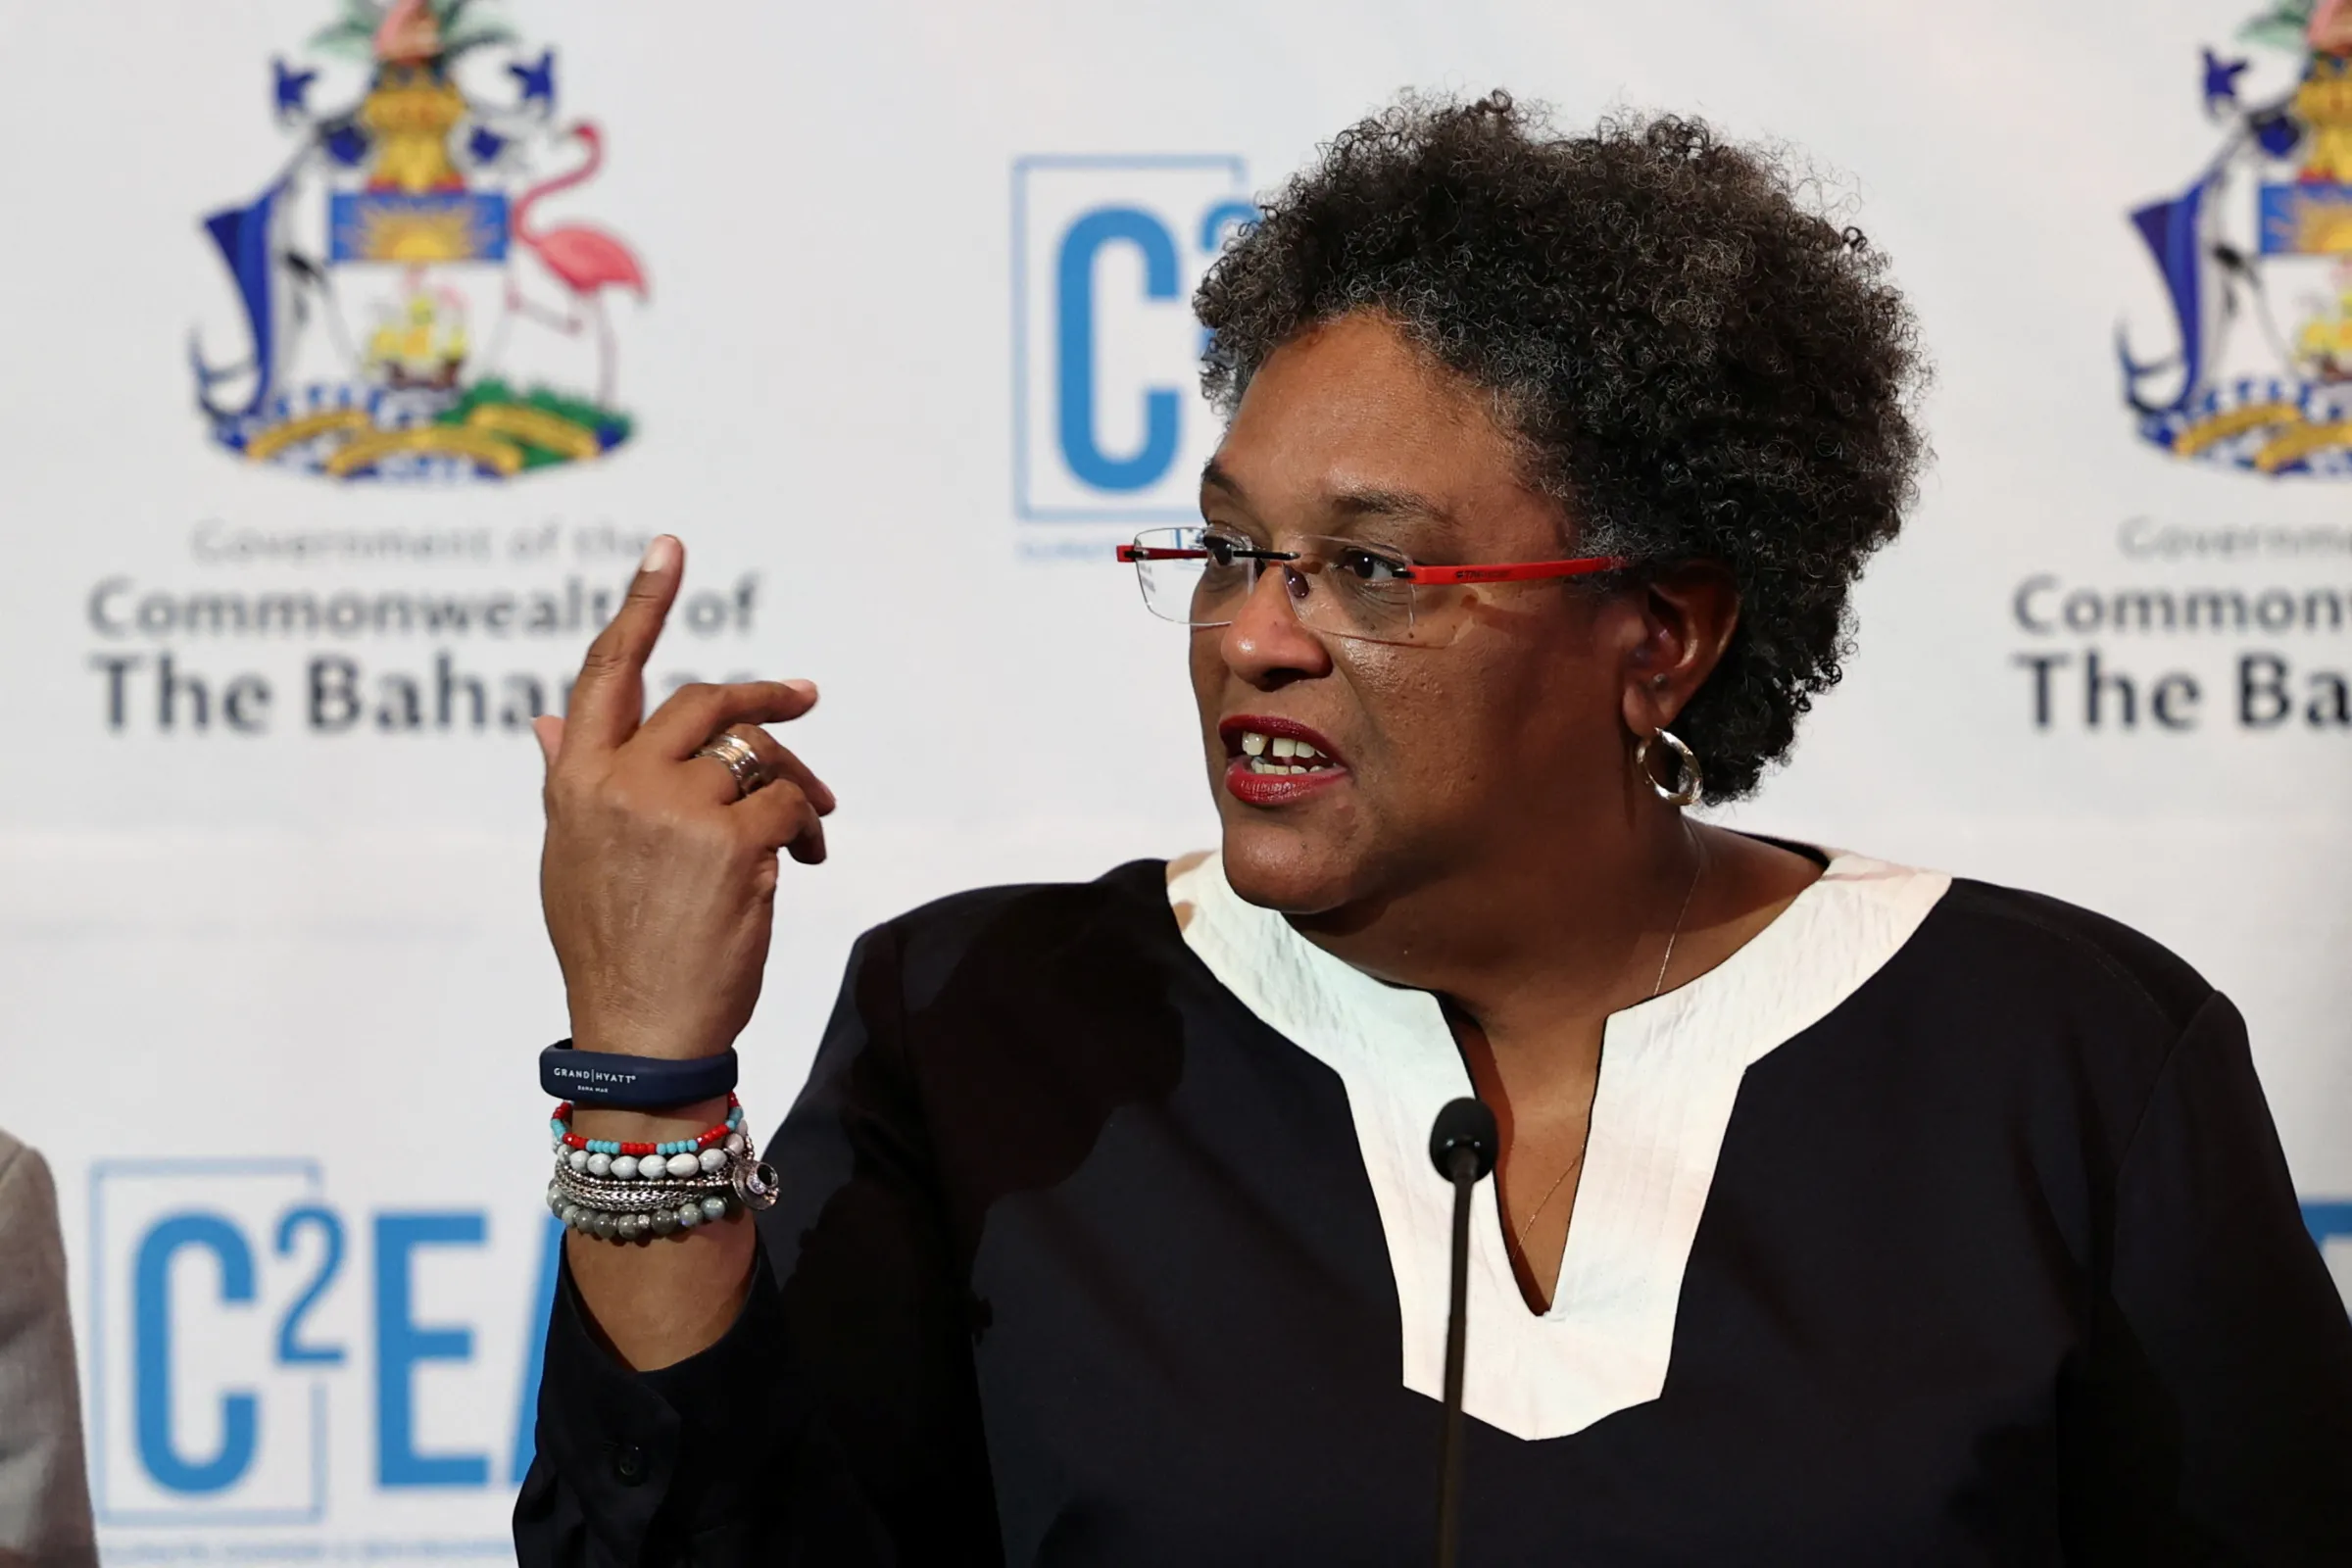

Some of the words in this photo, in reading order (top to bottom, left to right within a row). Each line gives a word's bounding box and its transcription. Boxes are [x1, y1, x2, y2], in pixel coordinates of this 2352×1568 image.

[507, 519, 560, 563] of
[85, 574, 633, 641] Commonwealt
[685, 569, 760, 636] of
[89, 649, 272, 737] The
[2013, 647, 2203, 734] The
[554, 1067, 590, 1079] GRAND
